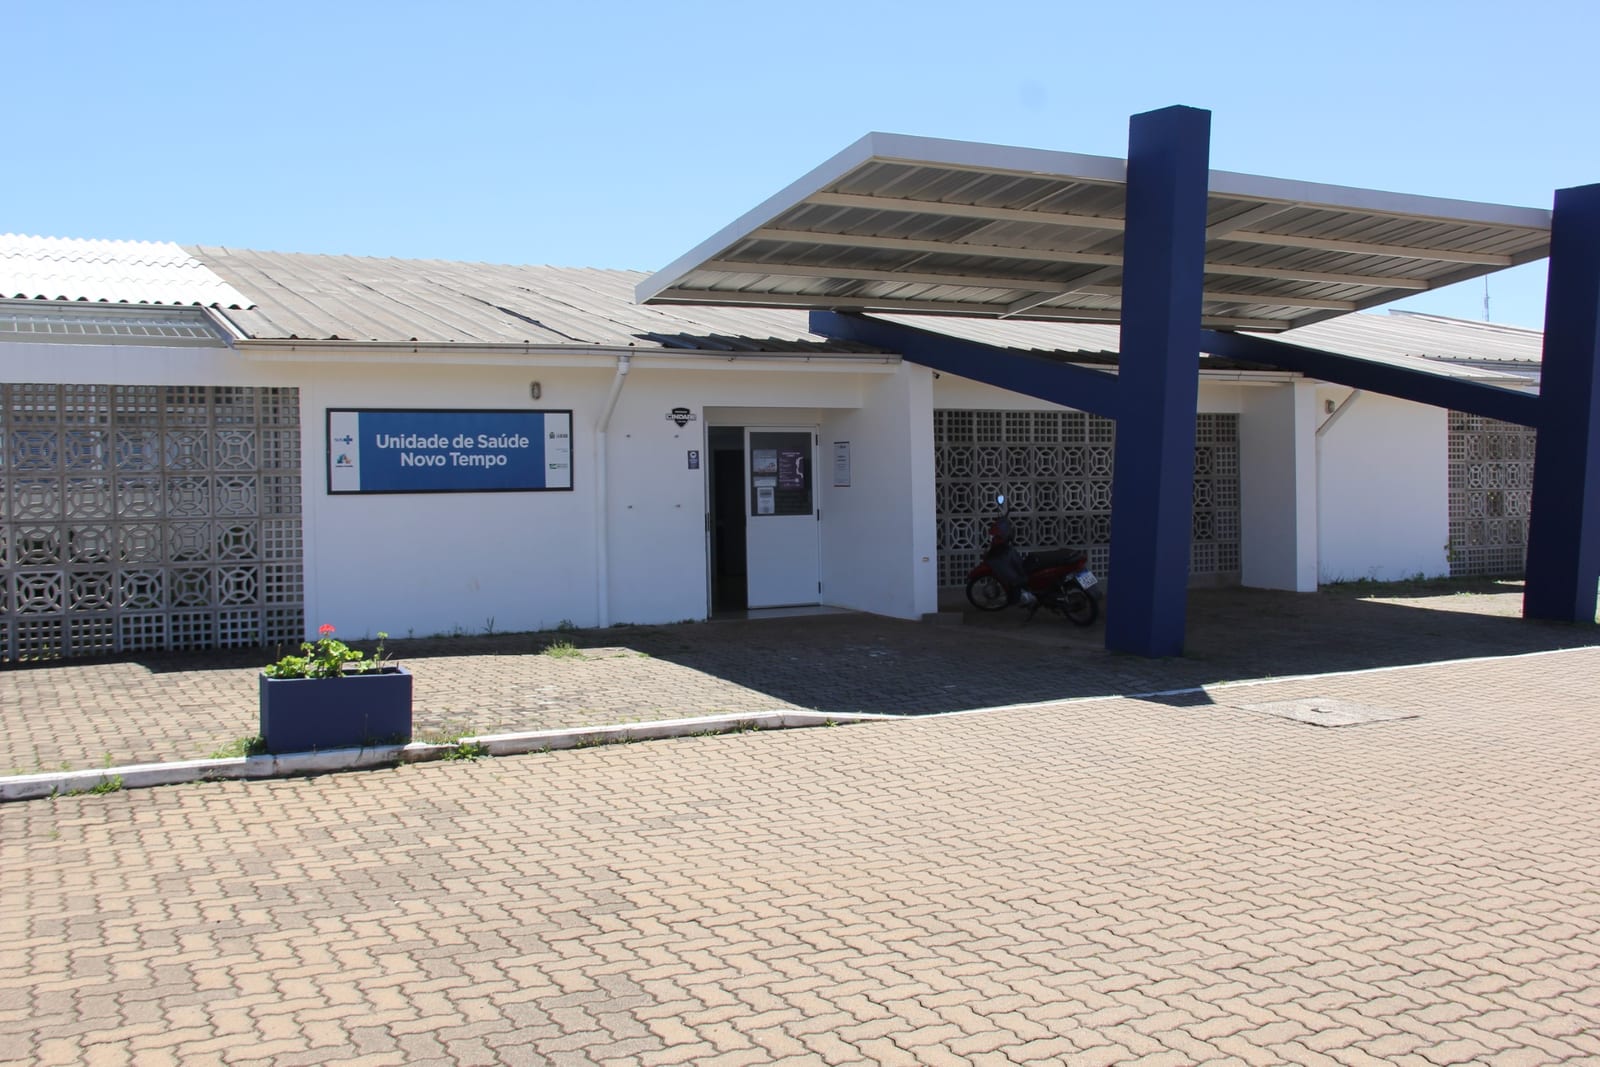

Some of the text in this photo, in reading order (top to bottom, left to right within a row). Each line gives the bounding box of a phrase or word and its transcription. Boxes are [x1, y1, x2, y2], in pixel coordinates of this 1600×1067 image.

[376, 433, 529, 449] Unidade de Saúde
[401, 452, 507, 469] Novo Tempo
